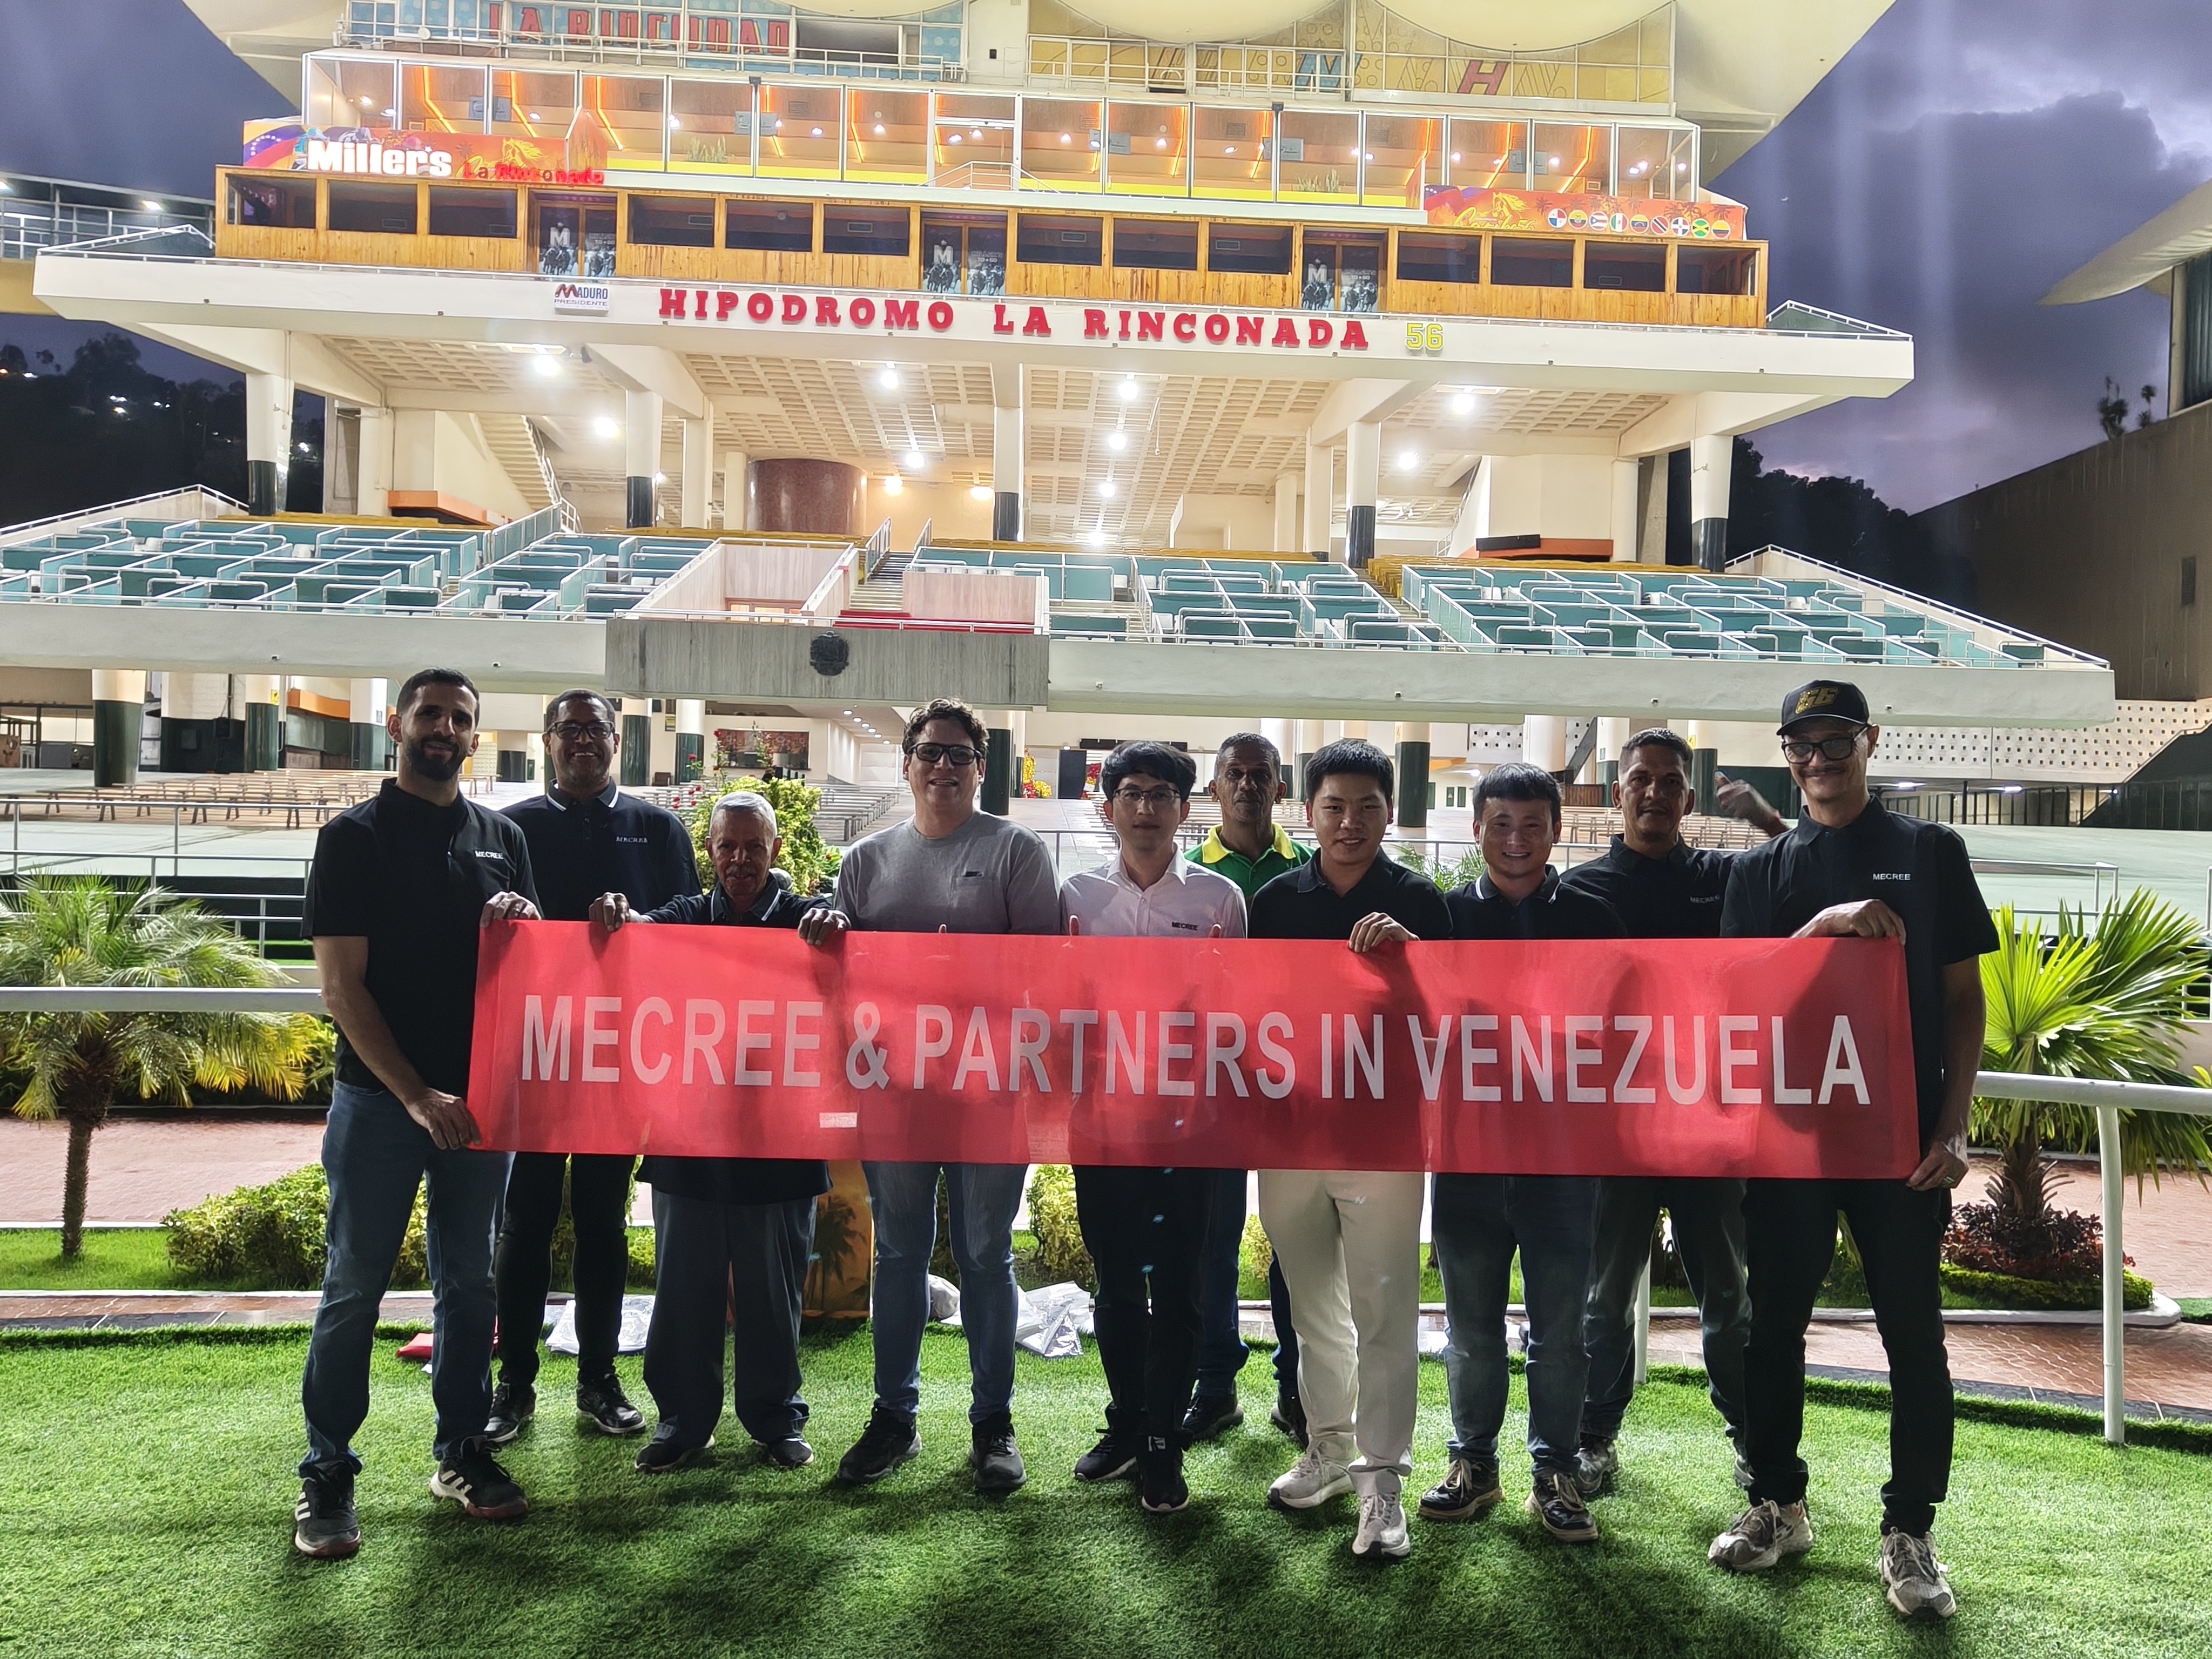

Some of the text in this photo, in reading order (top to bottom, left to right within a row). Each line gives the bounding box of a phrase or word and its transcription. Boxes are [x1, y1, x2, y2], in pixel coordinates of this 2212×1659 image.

[555, 284, 608, 299] MADURO
[659, 288, 1368, 350] HIPODROMO LA RINCONADA
[1405, 322, 1444, 351] 56
[475, 850, 504, 860] MECREE
[1171, 921, 1198, 931] MECREE
[521, 994, 1871, 1105] MECREE & PARTNERS IN VENEZUELA
